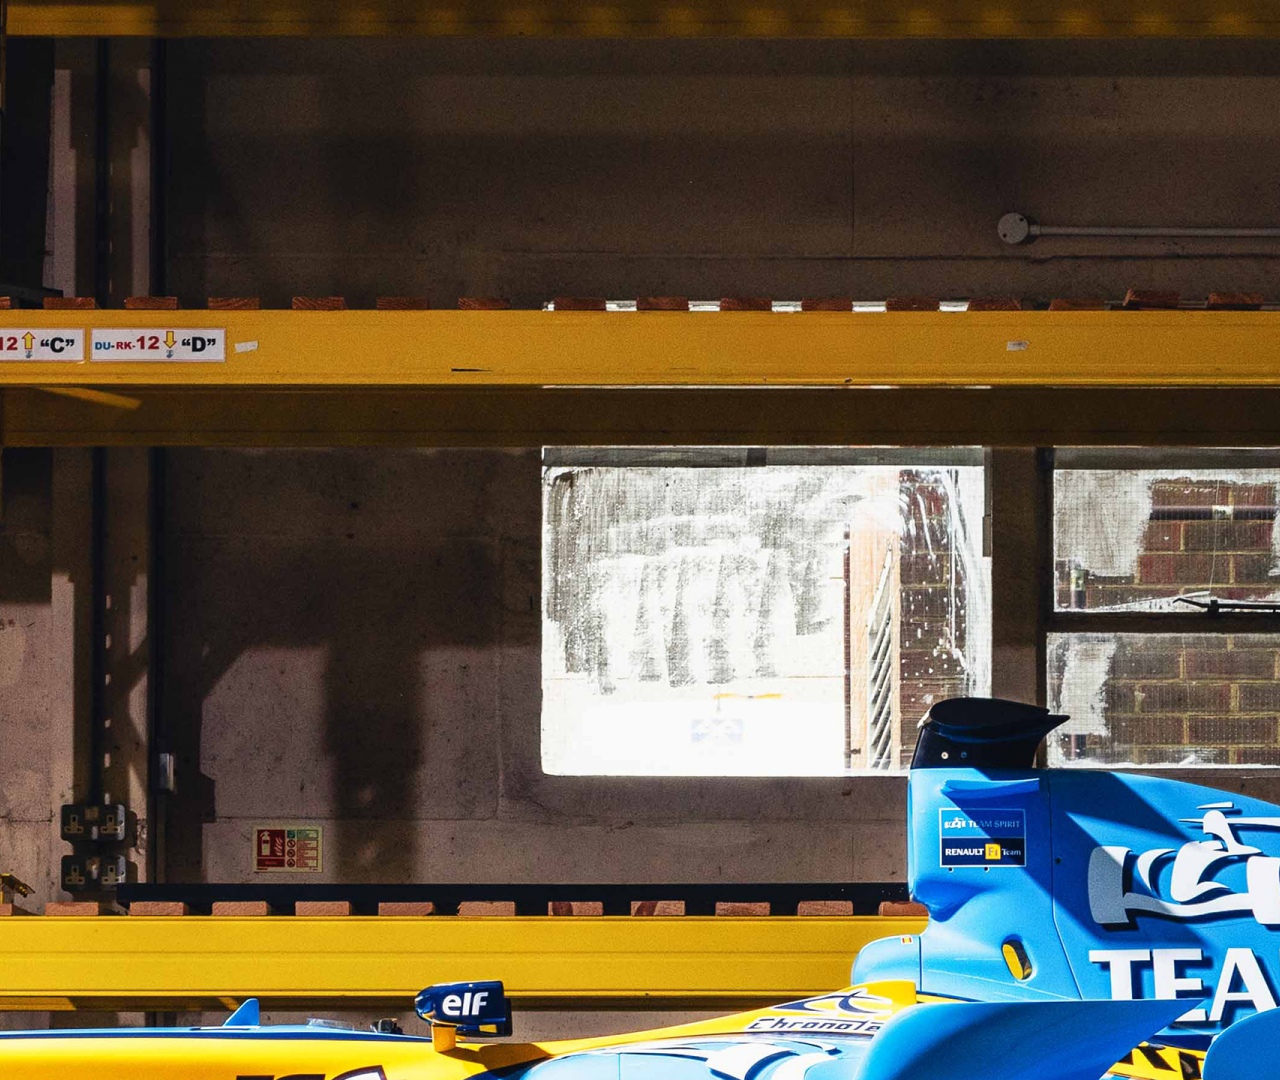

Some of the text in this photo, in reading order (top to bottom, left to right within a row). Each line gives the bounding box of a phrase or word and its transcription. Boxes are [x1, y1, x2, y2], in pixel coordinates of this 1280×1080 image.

[94, 336, 160, 351] DU-RK-12
[968, 820, 1020, 828] TEAM SPIRIT
[945, 848, 984, 856] RENAULT
[1002, 848, 1022, 856] Team
[442, 992, 489, 1016] elf
